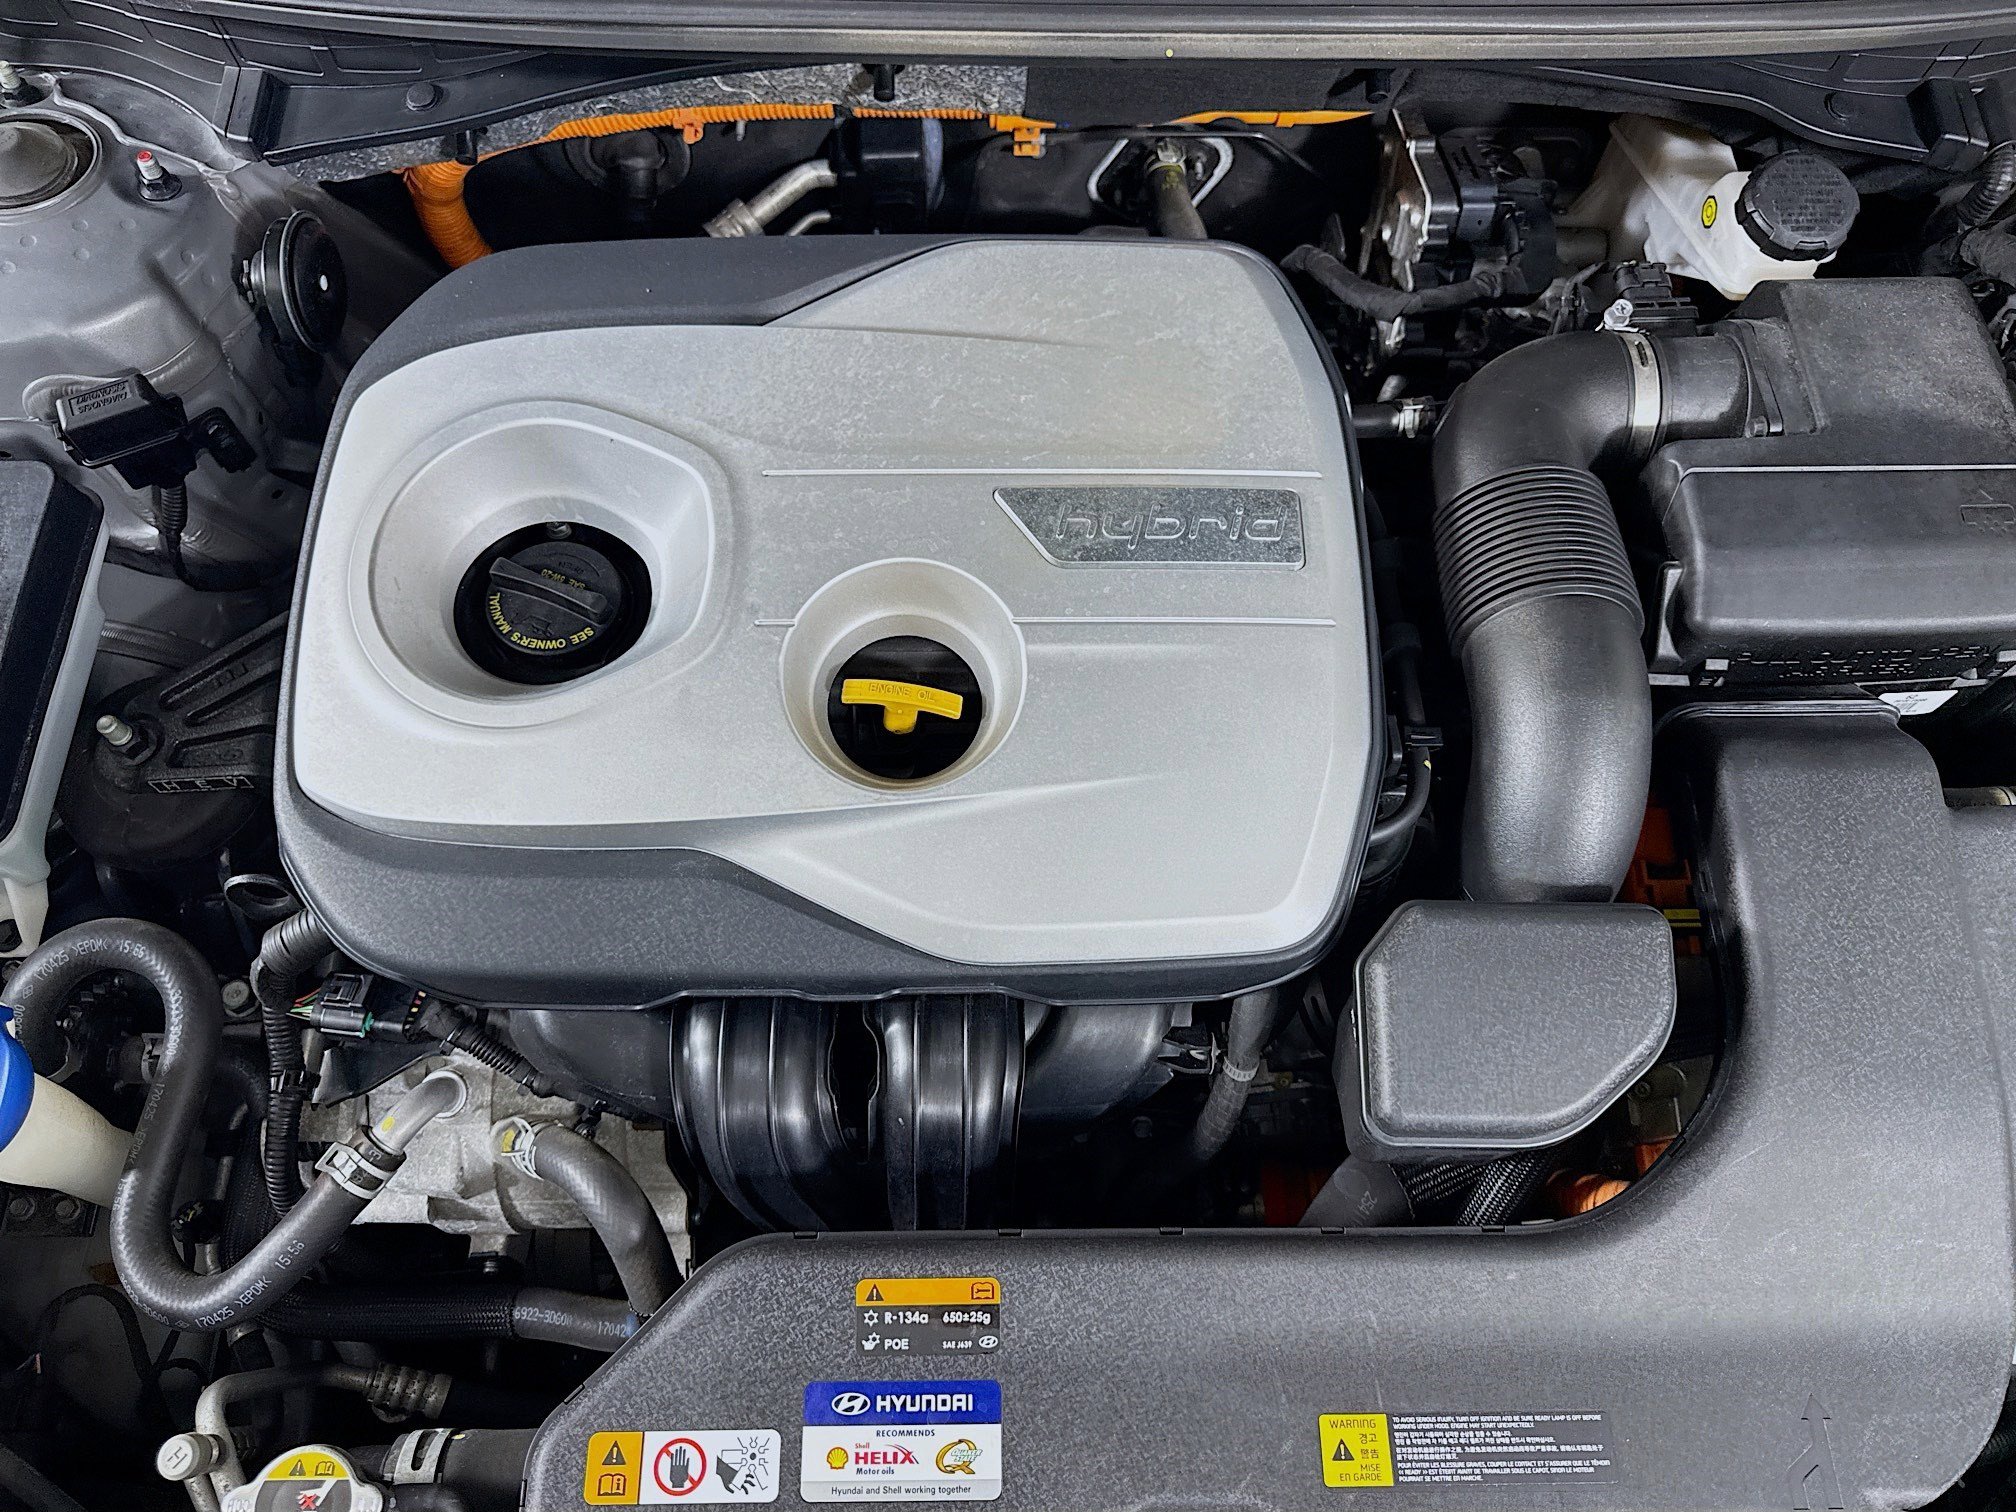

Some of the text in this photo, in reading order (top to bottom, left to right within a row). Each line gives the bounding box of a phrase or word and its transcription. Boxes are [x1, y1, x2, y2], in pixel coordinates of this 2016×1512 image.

[1055, 503, 1288, 550] hybrid
[568, 578, 586, 590] SAE
[489, 592, 595, 650] SEE OWNER'S MANUAL
[869, 682, 935, 702] ENGINE OIL
[33, 949, 70, 981] 170425
[143, 1082, 166, 1121] 170425
[194, 1305, 235, 1329] 170425
[274, 1239, 305, 1271] 15:56
[884, 1310, 991, 1325] R-134a 650±25g
[884, 1338, 972, 1350] POE SAE J639
[876, 1393, 973, 1413] HYUNDAI
[1329, 1418, 1376, 1429] WARNING
[876, 1429, 935, 1438] RECOMMENDS
[1359, 1433, 1377, 1445] 경고
[855, 1450, 917, 1465] HELIX
[951, 1449, 983, 1457] QUAKER
[856, 1467, 895, 1475] Motor oils
[1360, 1463, 1381, 1472] MISE
[1340, 1473, 1382, 1482] EN GARDE
[831, 1486, 971, 1497] Hyundai and Shell working together
